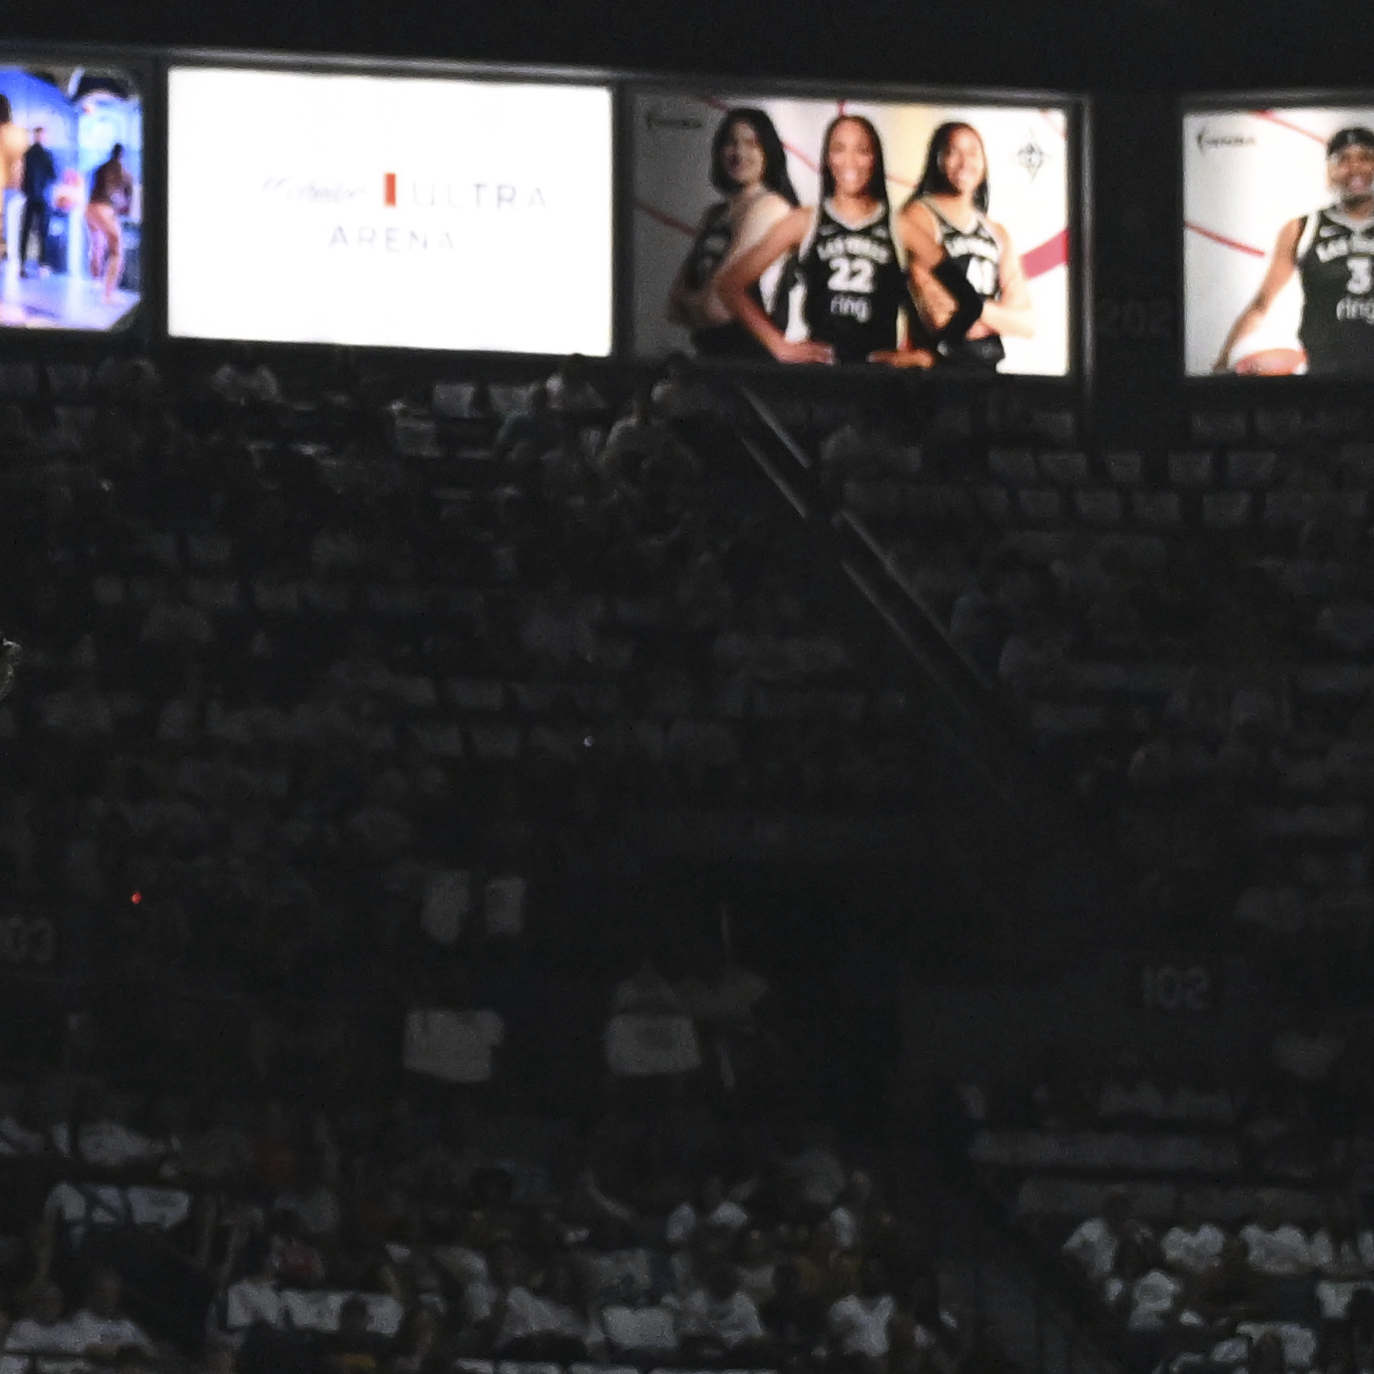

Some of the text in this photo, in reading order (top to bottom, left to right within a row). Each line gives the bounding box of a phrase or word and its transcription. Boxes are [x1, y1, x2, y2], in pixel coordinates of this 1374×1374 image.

[410, 179, 548, 211] ULTRA
[327, 224, 456, 254] ARENA
[827, 256, 875, 294] 22
